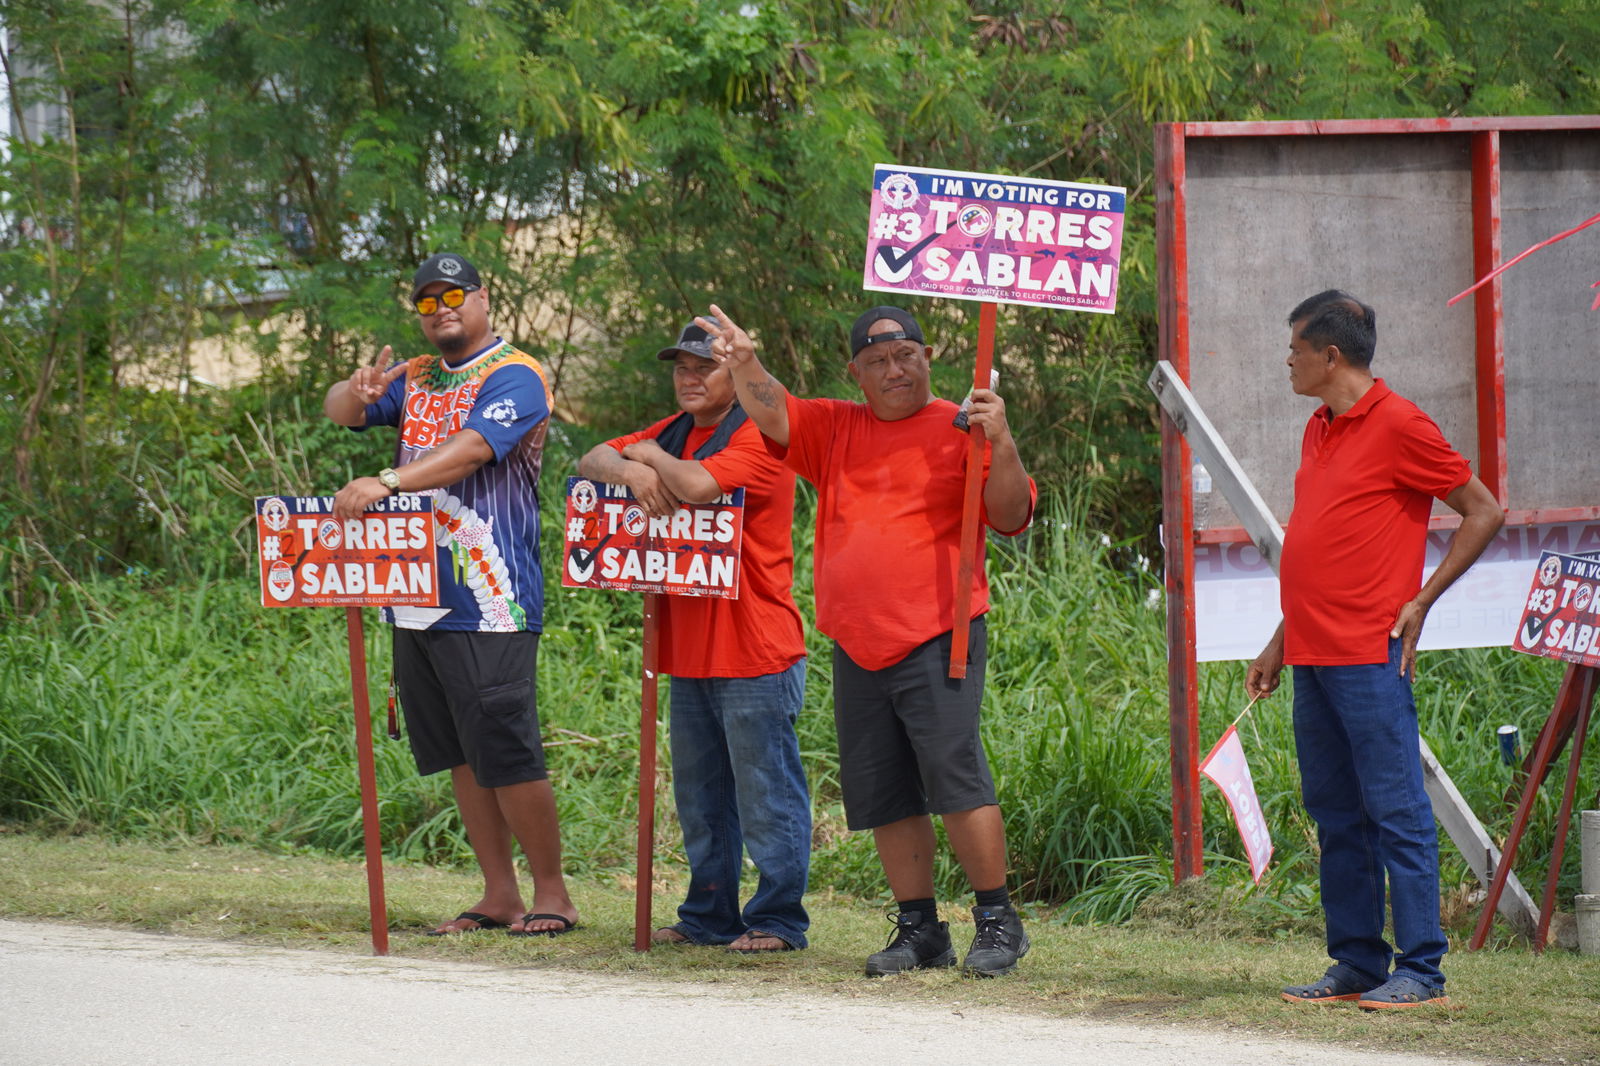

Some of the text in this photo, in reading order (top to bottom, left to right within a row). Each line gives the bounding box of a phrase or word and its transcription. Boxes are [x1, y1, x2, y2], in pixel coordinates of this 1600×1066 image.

[931, 177, 964, 196] I'M
[971, 181, 1059, 206] VOTING
[1065, 191, 1111, 211] FOR
[873, 211, 922, 243] #3
[929, 200, 1113, 250] TORRES
[922, 247, 1113, 298] SABLAN
[920, 282, 938, 290] PAID
[939, 284, 954, 292] FOR
[955, 285, 965, 293] BY
[966, 287, 1010, 297] COMMITTEE
[1023, 292, 1045, 301] ELECT
[1047, 294, 1076, 303] TORRES
[1077, 297, 1105, 306] SABLAN
[296, 497, 320, 513] I'M
[389, 496, 422, 512] FOR
[605, 483, 627, 498] I'M
[297, 517, 428, 550] TORRES
[604, 503, 735, 543] TORRES
[301, 562, 432, 595] SABLAN
[601, 547, 735, 588] SABLAN
[1568, 560, 1586, 577] I'M
[1527, 588, 1557, 614] #3
